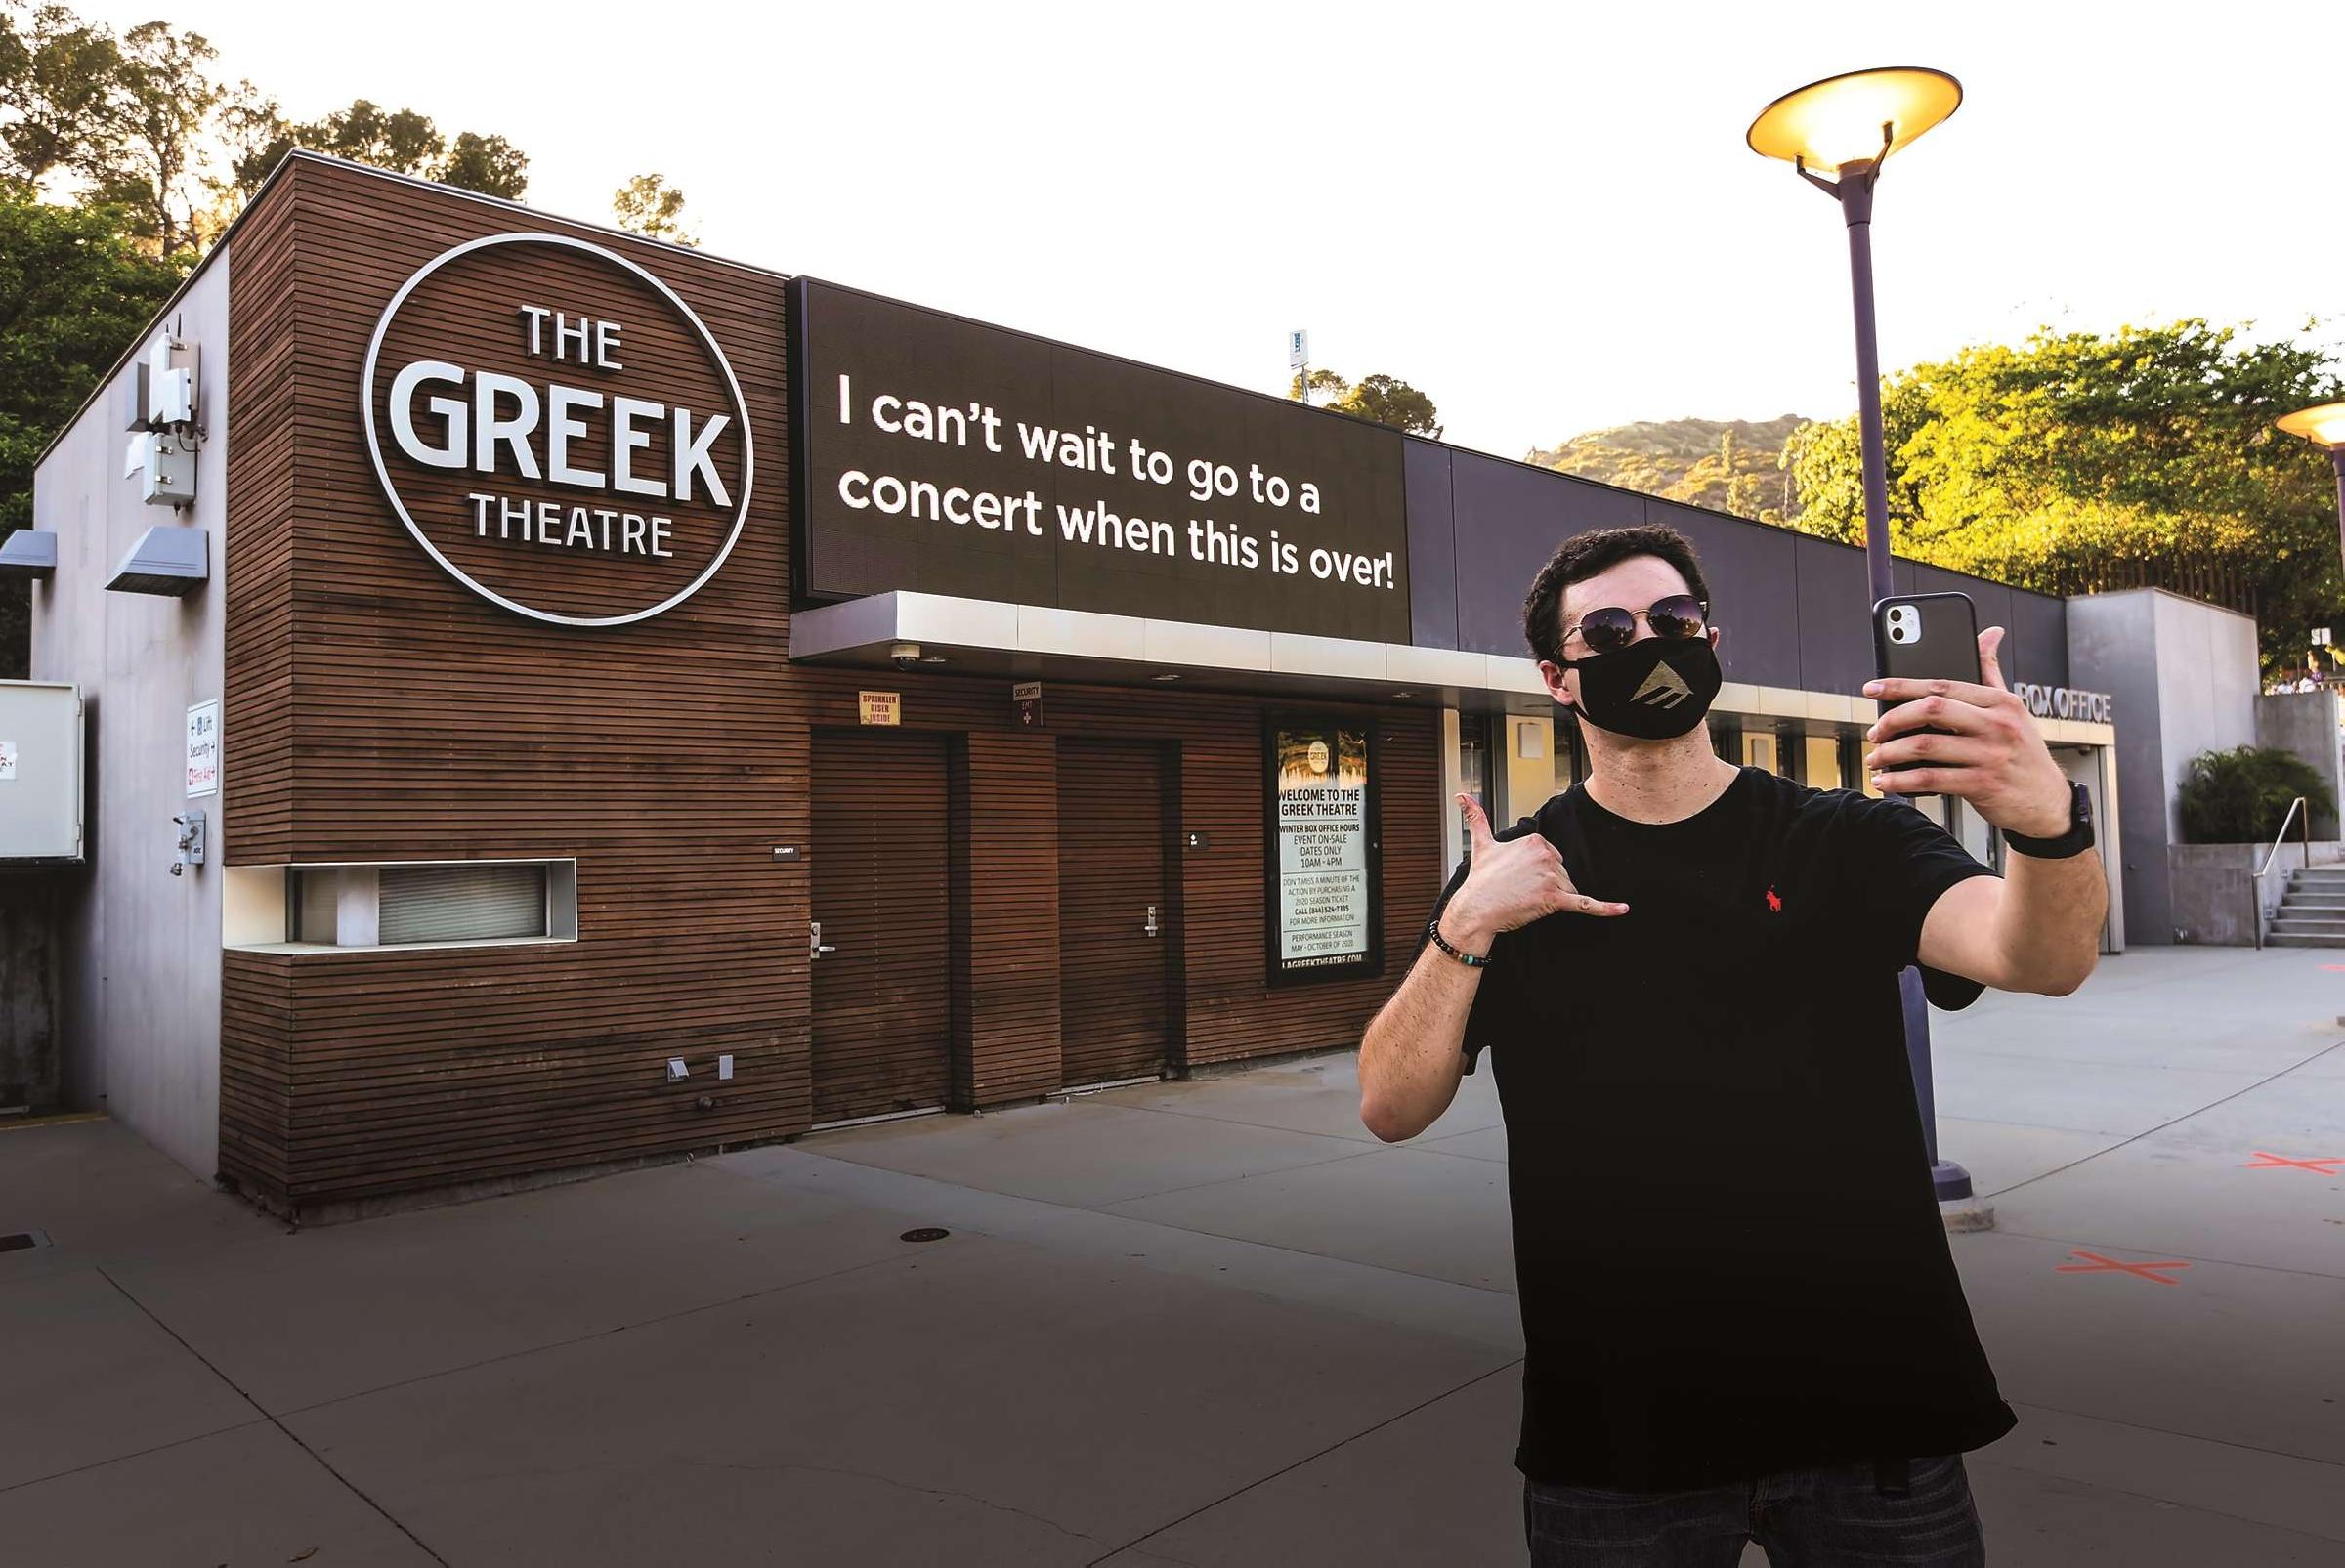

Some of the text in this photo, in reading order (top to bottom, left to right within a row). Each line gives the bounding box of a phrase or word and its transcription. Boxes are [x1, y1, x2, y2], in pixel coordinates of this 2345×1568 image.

[519, 304, 623, 370] THE
[389, 360, 733, 507] GREEK
[839, 374, 1320, 515] I can't wait to go to a
[468, 492, 673, 558] THEATRE
[838, 470, 1393, 589] concert when this is over!
[1015, 686, 1039, 697] SECURITY
[862, 695, 897, 703] SPRINKLER
[2014, 682, 2111, 723] BOX OFFICE
[190, 741, 209, 758] Security
[1279, 789, 1359, 801] WELCOME TO THE
[1282, 804, 1357, 816] GREEK THEATRE
[1280, 824, 1359, 833] WINTER BOX OFFICE HOURS
[1294, 834, 1347, 845] EVENT ON-SALE
[1300, 846, 1342, 856] DATES ONLY
[1301, 858, 1321, 868] 10AM
[1327, 857, 1342, 867] 4PM
